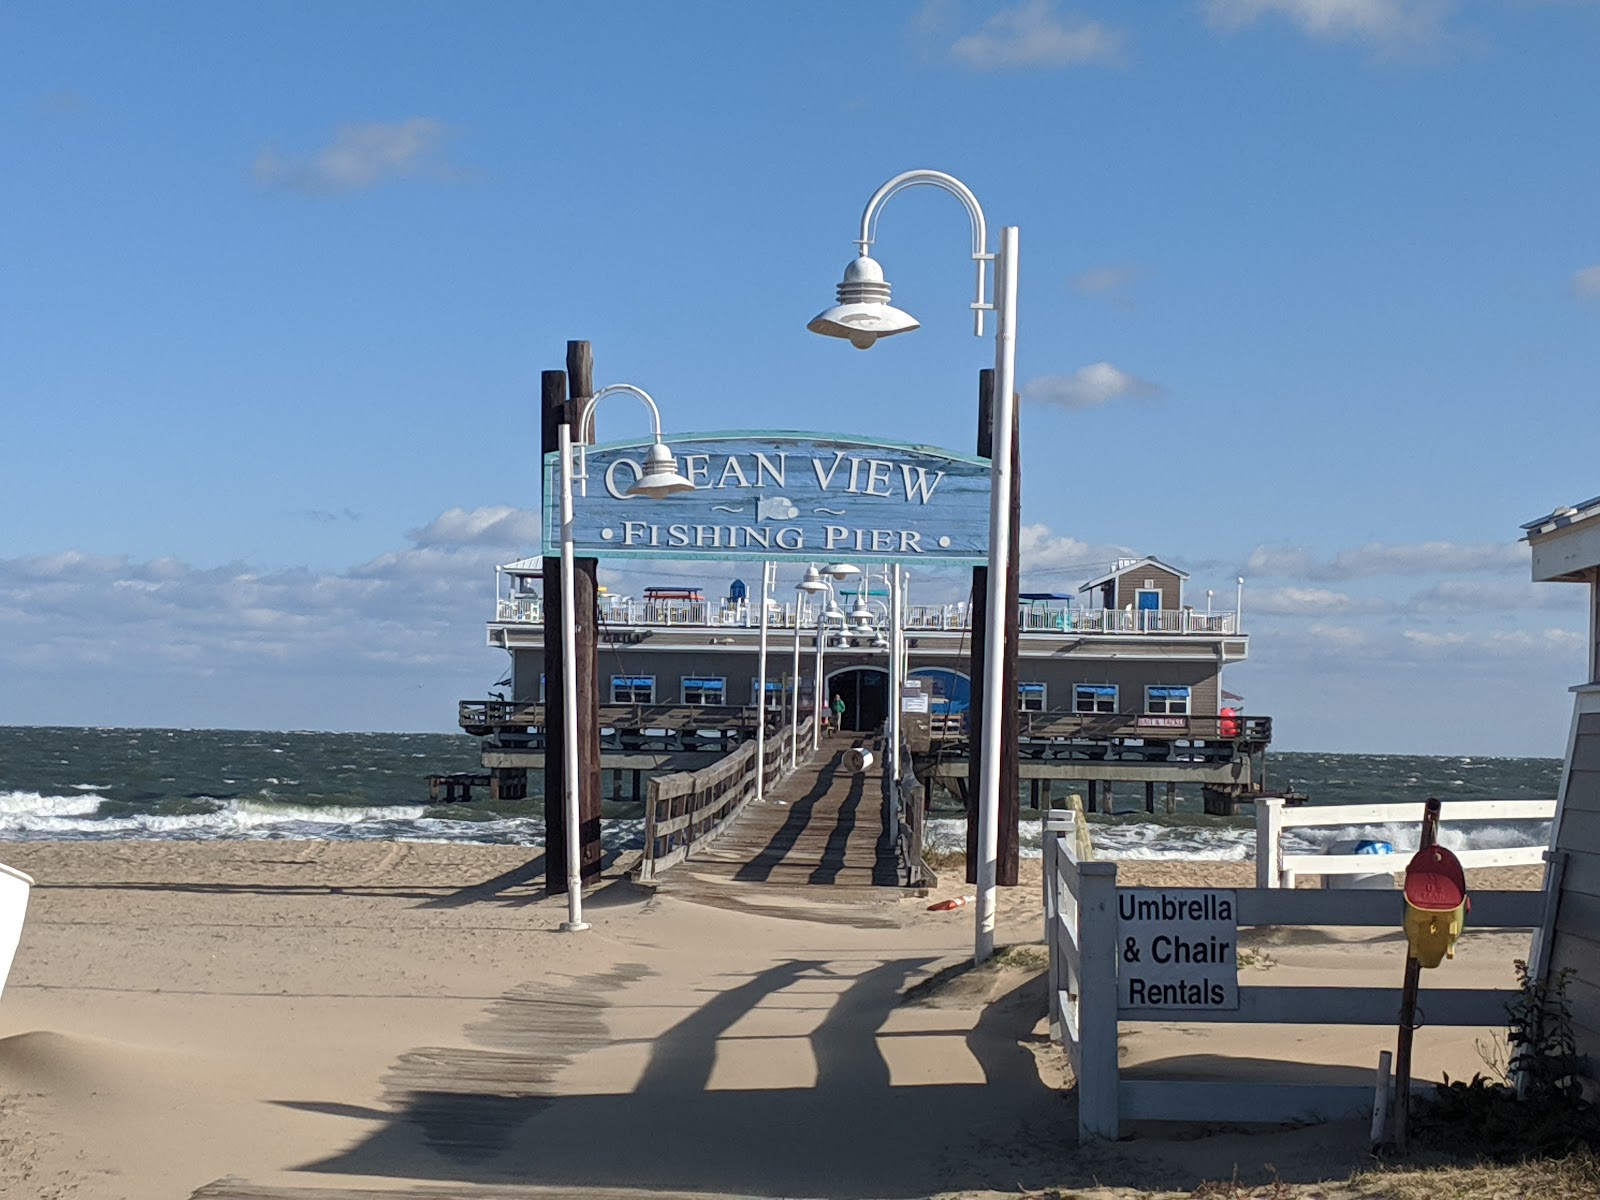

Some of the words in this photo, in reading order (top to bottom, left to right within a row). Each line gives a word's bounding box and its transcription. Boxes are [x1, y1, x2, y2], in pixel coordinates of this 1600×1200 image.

[604, 451, 788, 500] OEAN
[812, 450, 946, 505] VIEW
[621, 520, 803, 550] FISHING
[823, 525, 925, 553] PIER
[1118, 894, 1232, 921] Umbrella
[1123, 936, 1140, 963] &
[1151, 935, 1230, 964] Chair
[1129, 978, 1225, 1005] Rentals
